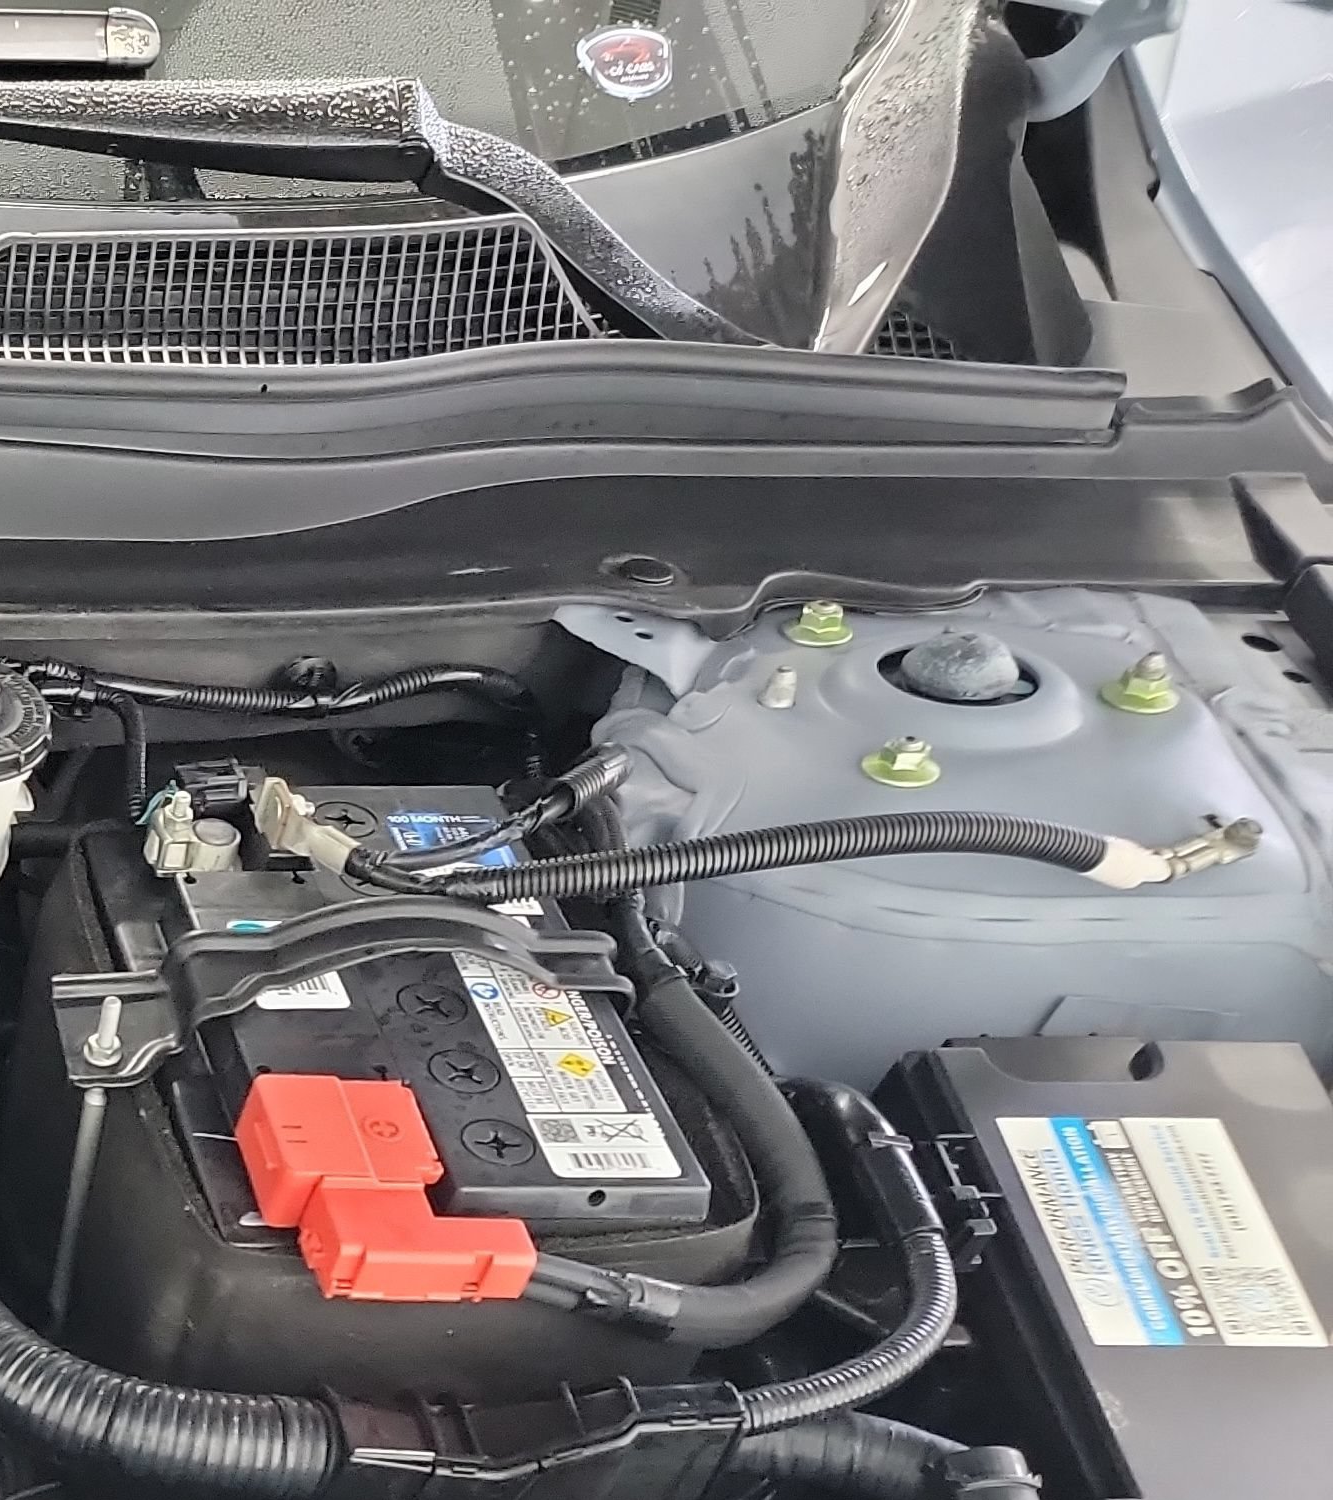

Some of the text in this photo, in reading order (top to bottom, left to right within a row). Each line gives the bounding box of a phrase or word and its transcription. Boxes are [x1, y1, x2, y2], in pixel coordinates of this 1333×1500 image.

[386, 815, 462, 823] 100 MONTH
[566, 991, 617, 1065] NGER/POISON
[1023, 1149, 1087, 1275] PERFORMANCE
[1042, 1147, 1110, 1274] KINGS Honda
[1137, 1226, 1219, 1336] 10% OFF
